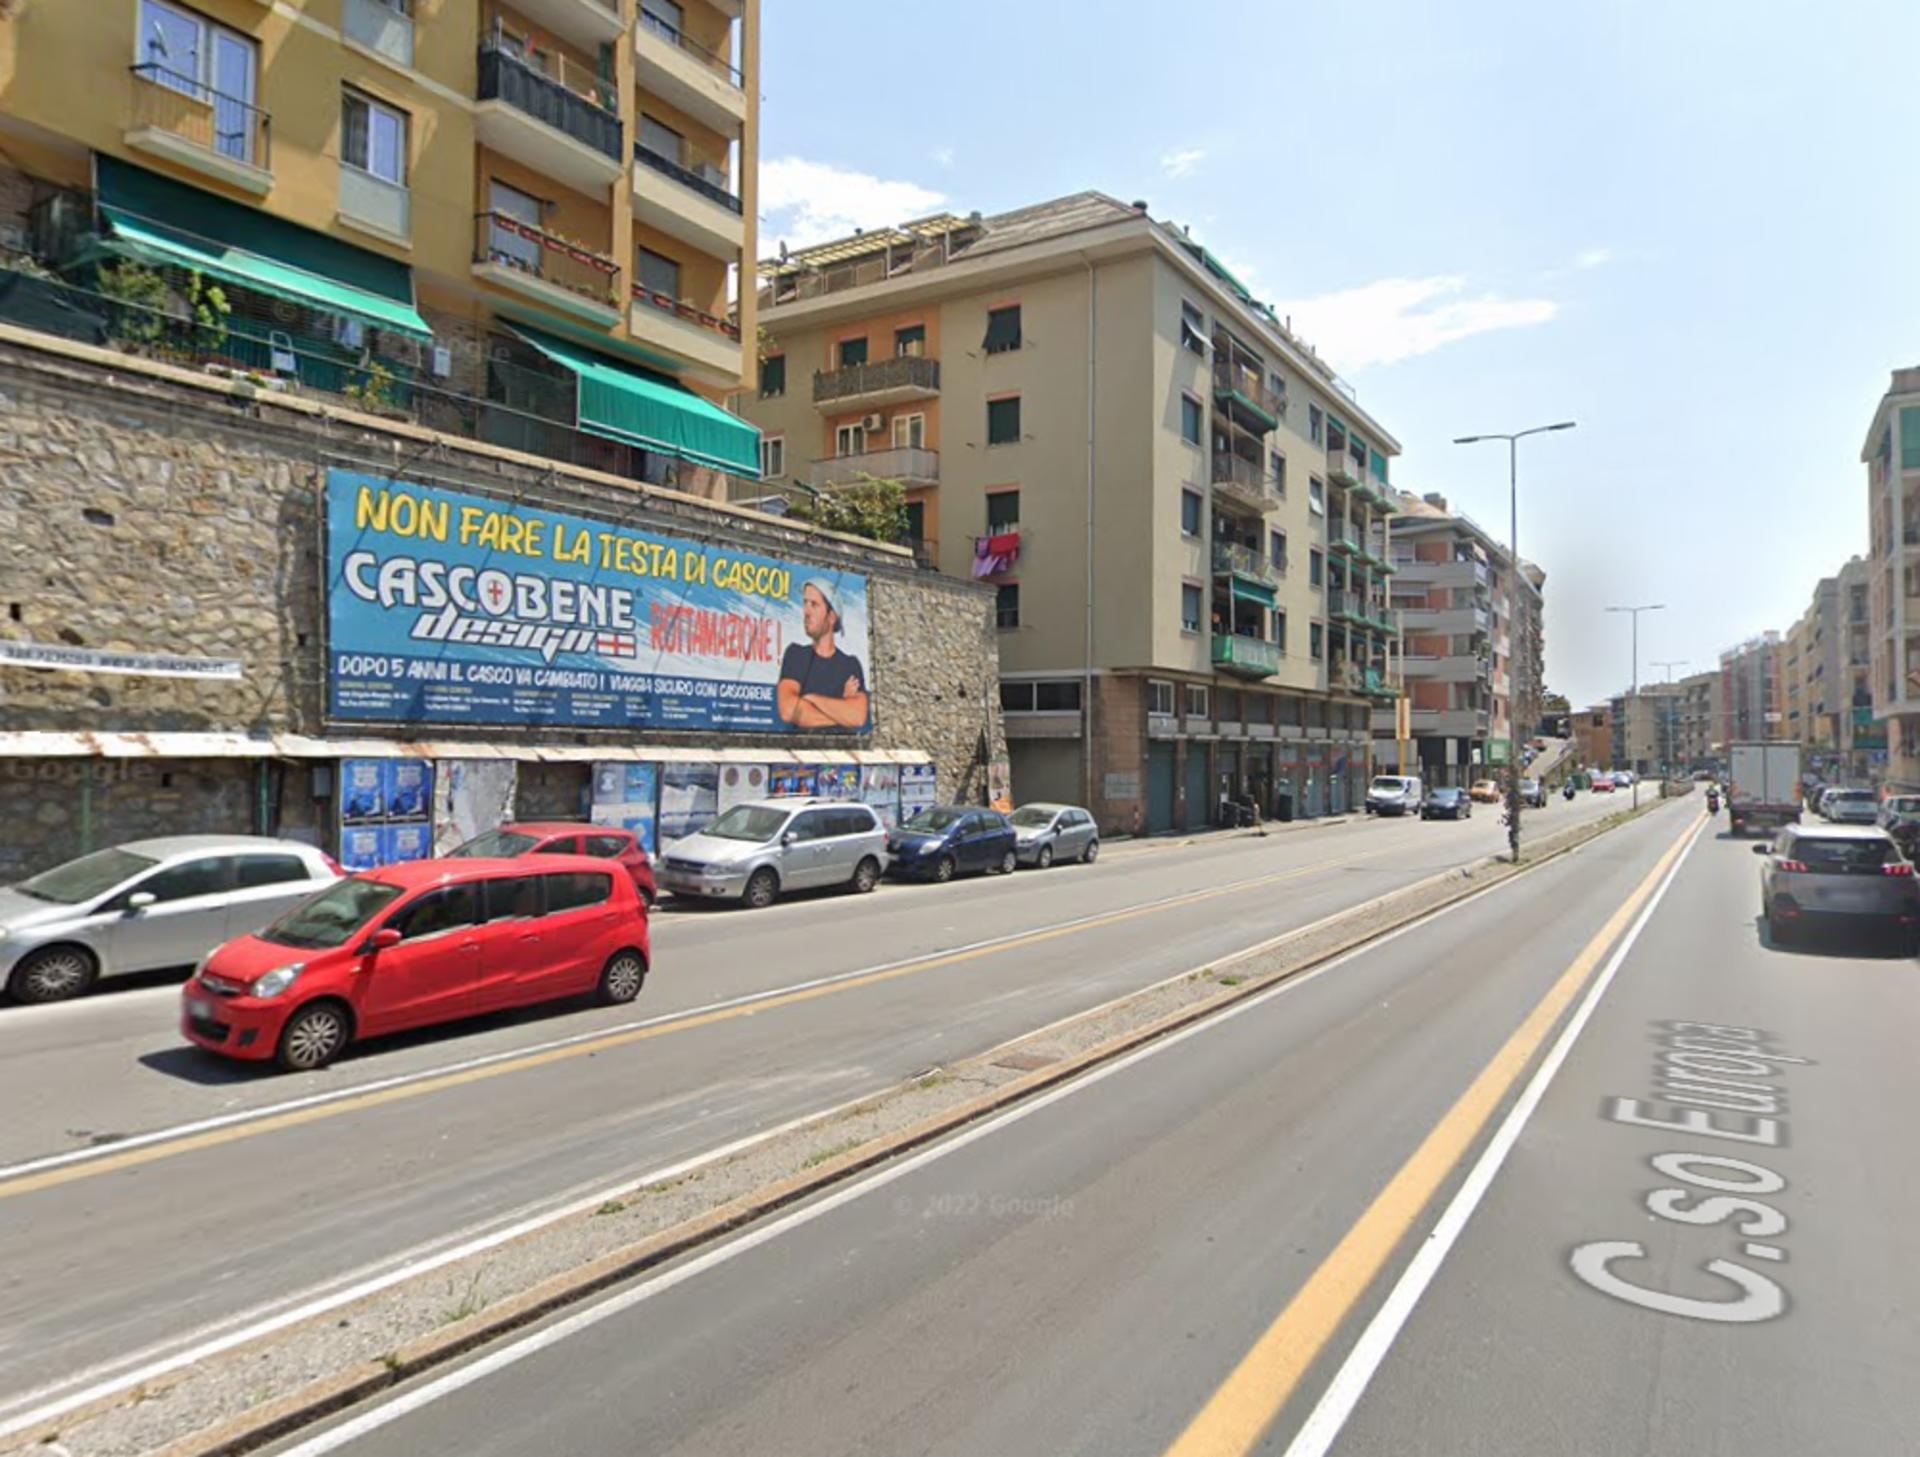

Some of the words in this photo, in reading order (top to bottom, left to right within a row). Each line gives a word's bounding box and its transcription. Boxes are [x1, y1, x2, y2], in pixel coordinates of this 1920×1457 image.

[356, 485, 449, 542] NON
[460, 506, 545, 556] FARE
[553, 523, 591, 566] LA
[598, 532, 677, 581] TESTA
[683, 551, 706, 585] DI
[711, 557, 790, 600] CASCO!
[343, 551, 636, 630] CASCOBENE
[410, 602, 598, 664] design
[337, 655, 388, 677] DOPO
[391, 658, 404, 678] 5
[407, 658, 447, 681] ANNI
[450, 662, 464, 682] IL
[466, 664, 513, 685] CASCO
[515, 666, 532, 686] VA
[654, 679, 694, 697] SICURO
[695, 682, 717, 698] CON
[719, 684, 774, 701] CASCOBENE
